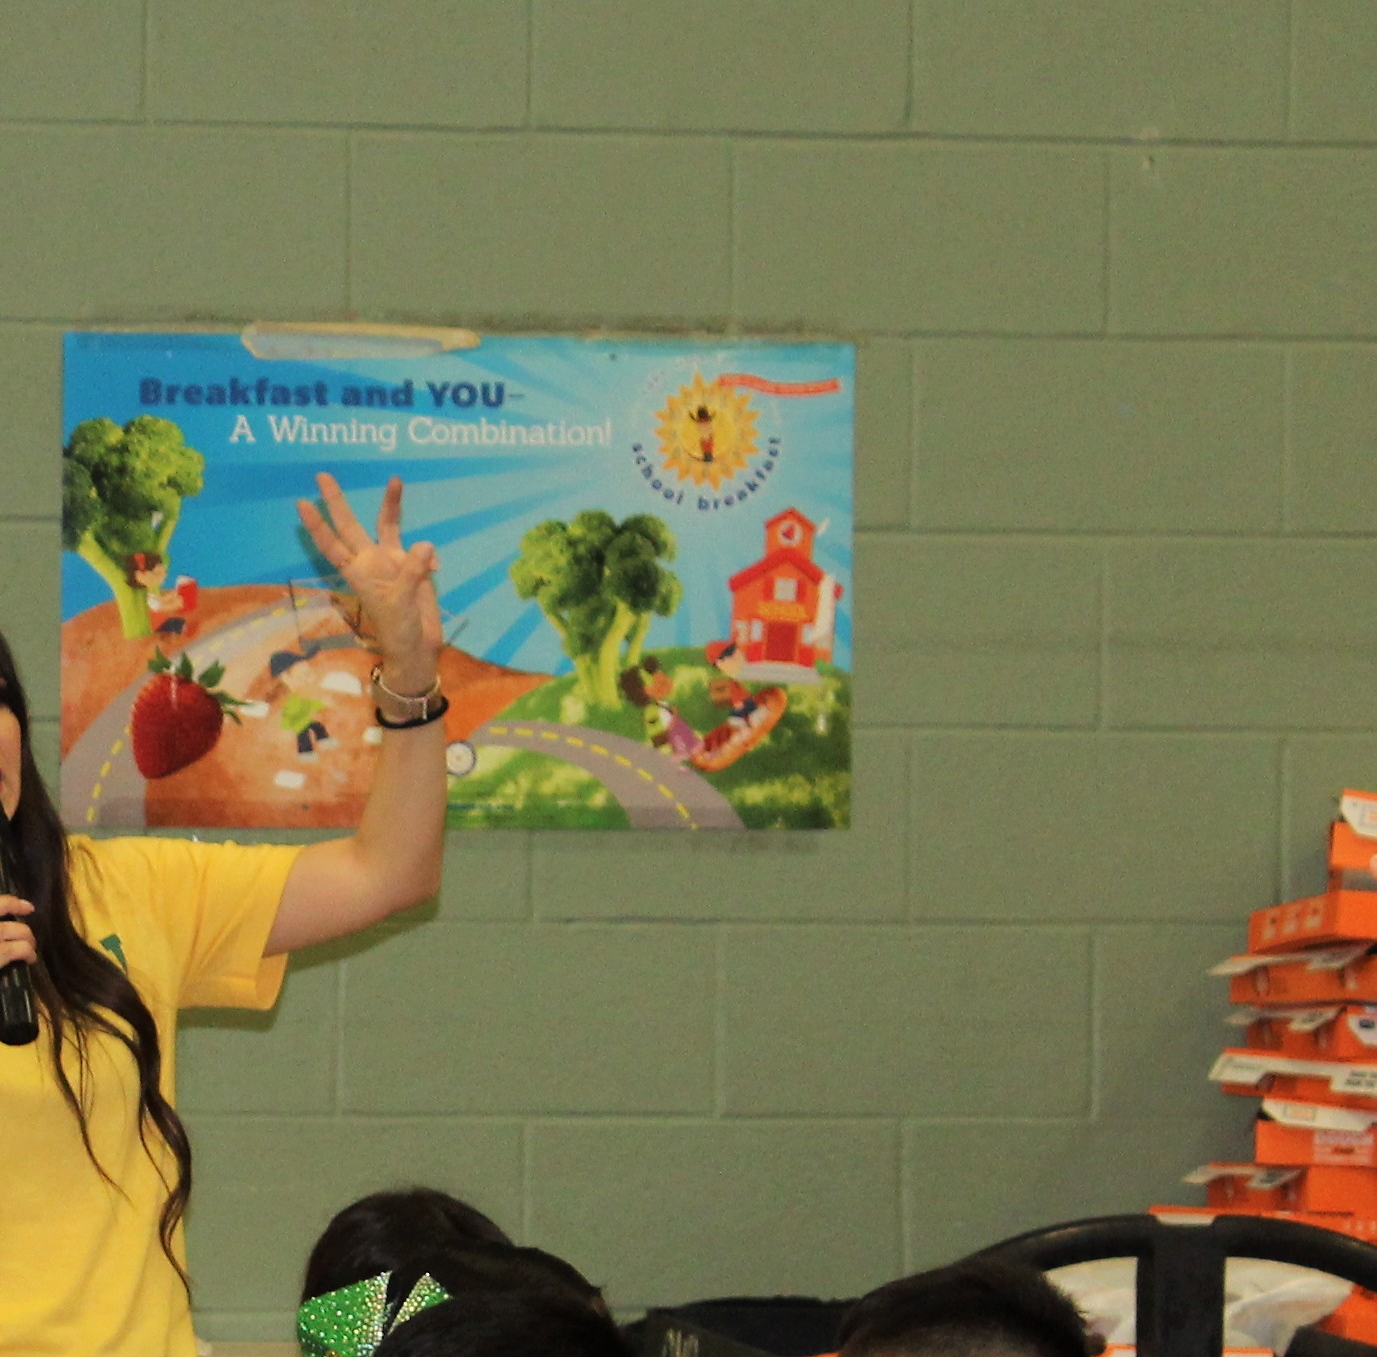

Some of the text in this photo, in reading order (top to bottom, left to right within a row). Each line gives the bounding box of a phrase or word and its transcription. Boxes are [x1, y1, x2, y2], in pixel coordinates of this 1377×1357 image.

[138, 376, 328, 407] Breakfast
[341, 378, 414, 408] and
[229, 414, 612, 453] A Winning Combination!
[632, 436, 781, 511] school breakfast
